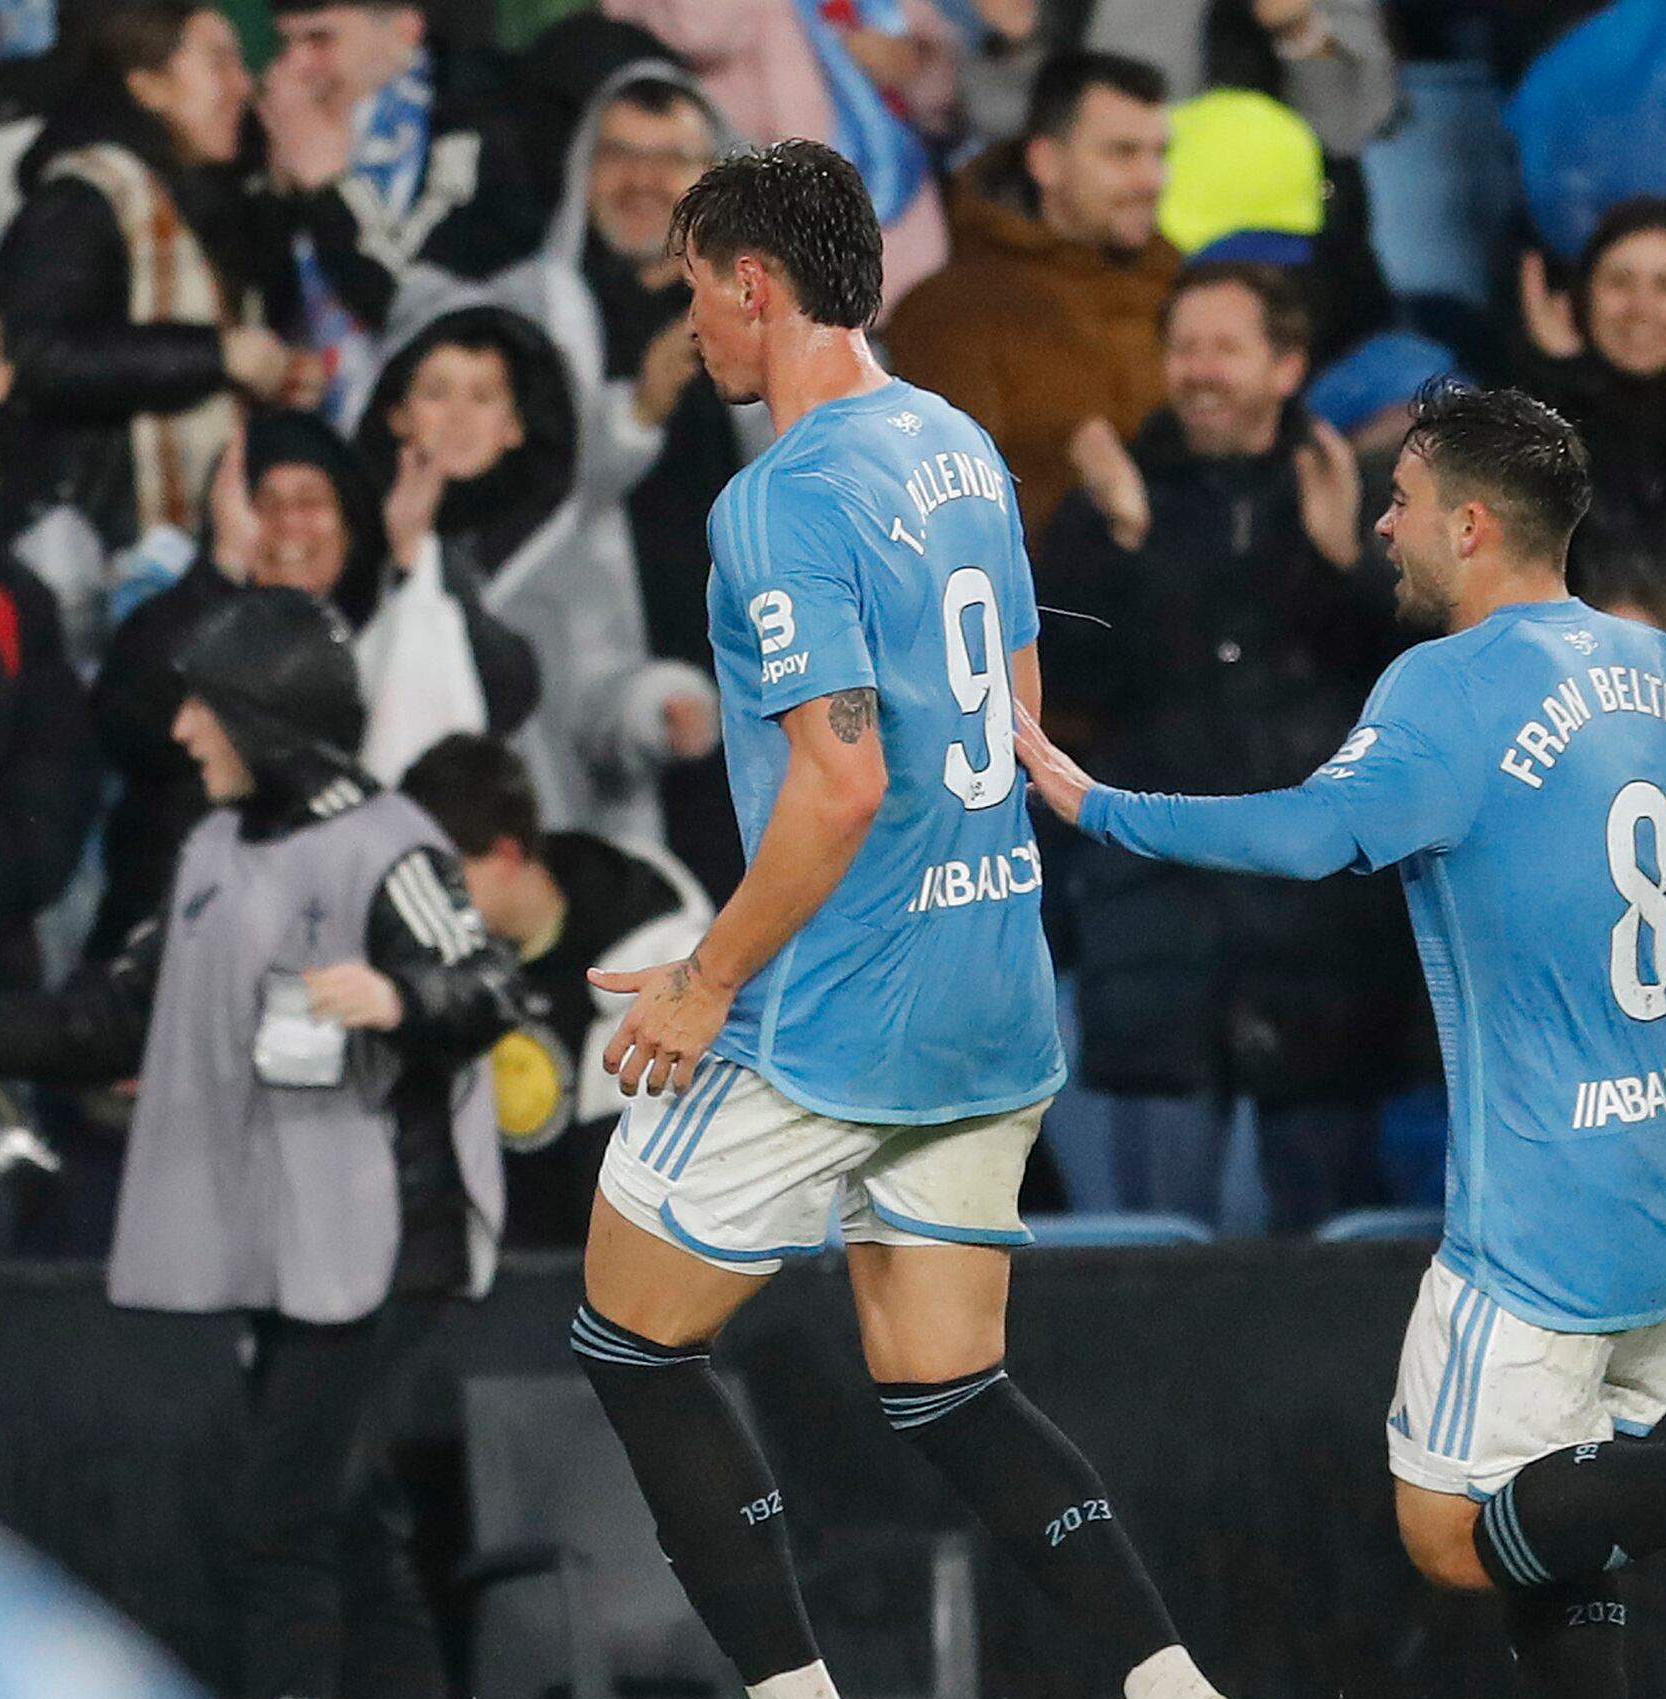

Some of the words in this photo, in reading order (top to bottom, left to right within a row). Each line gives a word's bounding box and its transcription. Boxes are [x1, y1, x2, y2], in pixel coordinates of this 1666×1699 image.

[942, 566, 1016, 810] 9
[1501, 677, 1592, 789] FRAN
[1045, 1499, 1113, 1547] 2023
